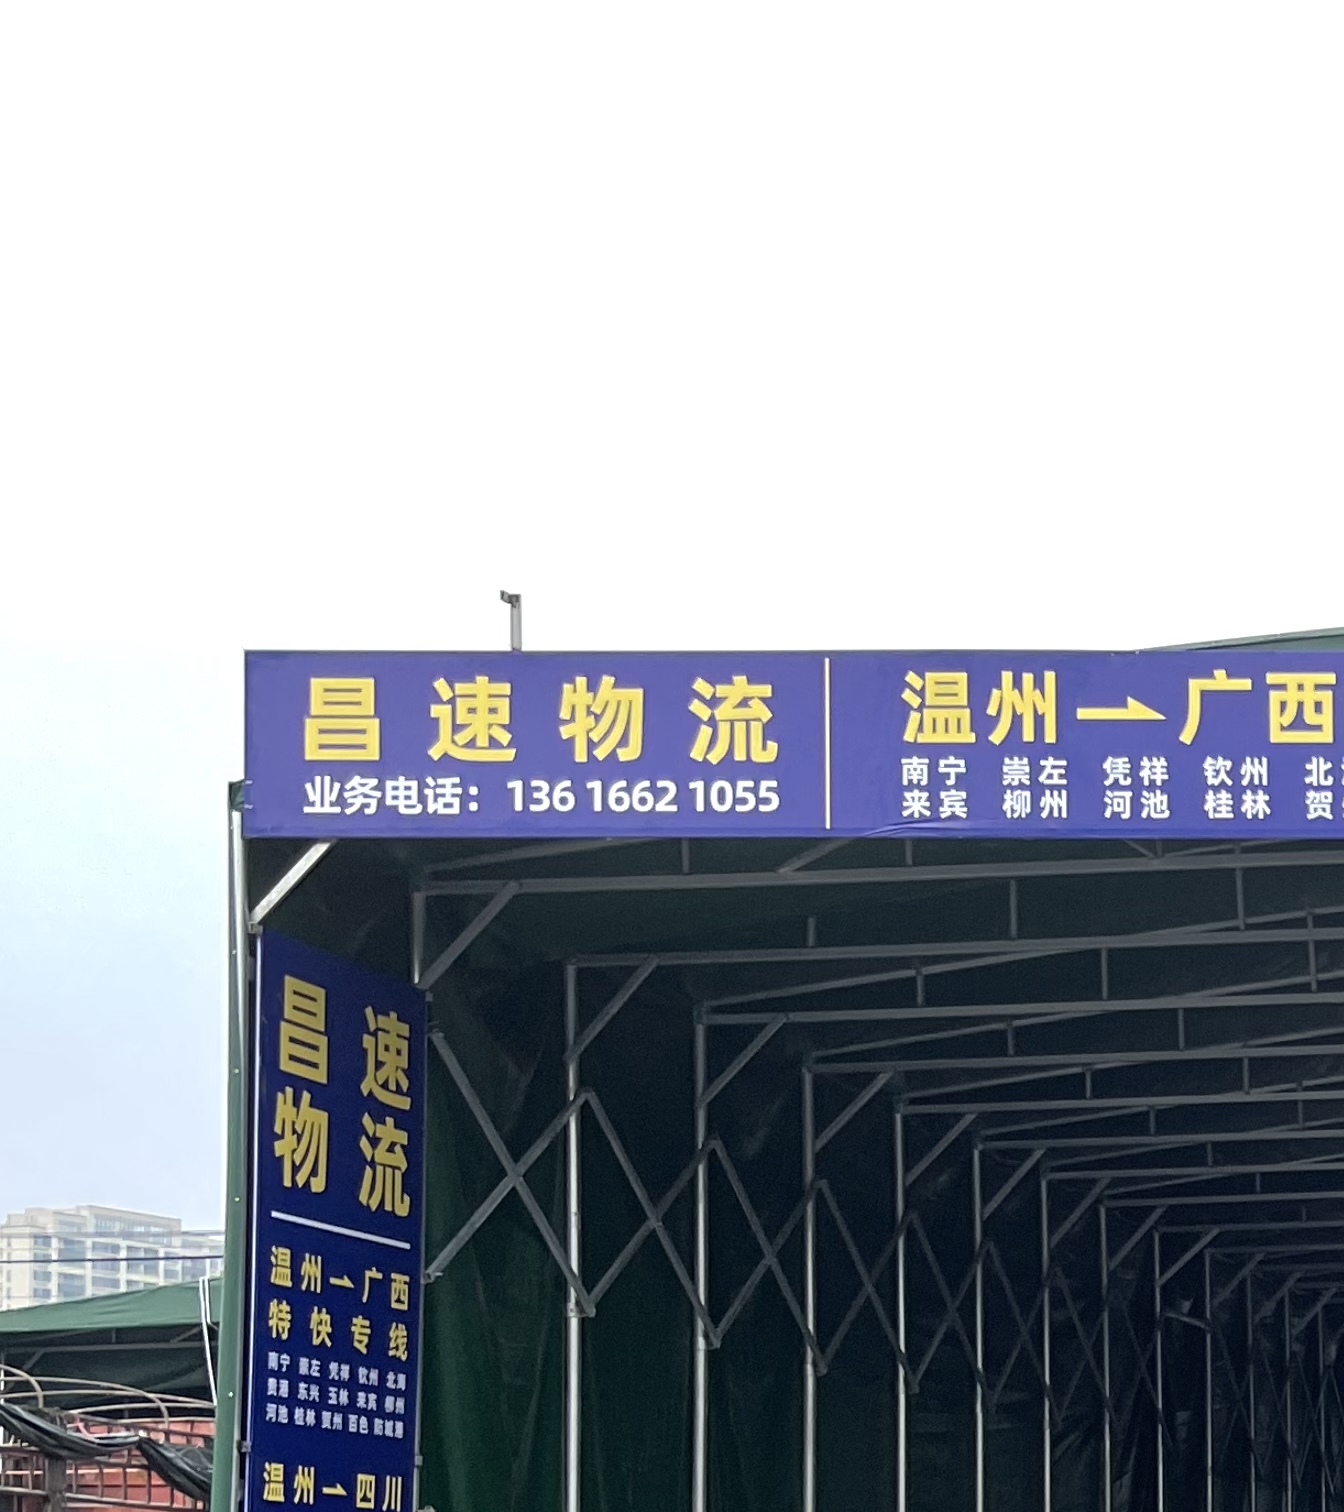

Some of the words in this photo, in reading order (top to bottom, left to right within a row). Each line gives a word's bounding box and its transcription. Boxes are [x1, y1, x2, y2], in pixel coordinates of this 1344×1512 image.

[304, 675, 778, 765] 昌速物流
[901, 671, 1056, 746] 温州
[507, 780, 575, 811] 136
[586, 780, 677, 812] 1662
[689, 780, 779, 812] 1055
[901, 756, 966, 786] 南宁
[1002, 756, 1067, 786] 崇左
[1103, 756, 1168, 786] 凭祥
[1203, 756, 1267, 786] 钦州
[902, 789, 967, 818] 来宾
[1002, 789, 1067, 818] 柳州
[1104, 790, 1170, 819] 河池
[1204, 789, 1270, 819] 桂林
[279, 974, 411, 1111] 昌速
[273, 1085, 411, 1217] 物流
[270, 1245, 322, 1294] 温州
[362, 1266, 410, 1311] 广西
[268, 1298, 408, 1362] 特快专线
[263, 1461, 315, 1505] 温州
[356, 1473, 402, 1512] 四川
